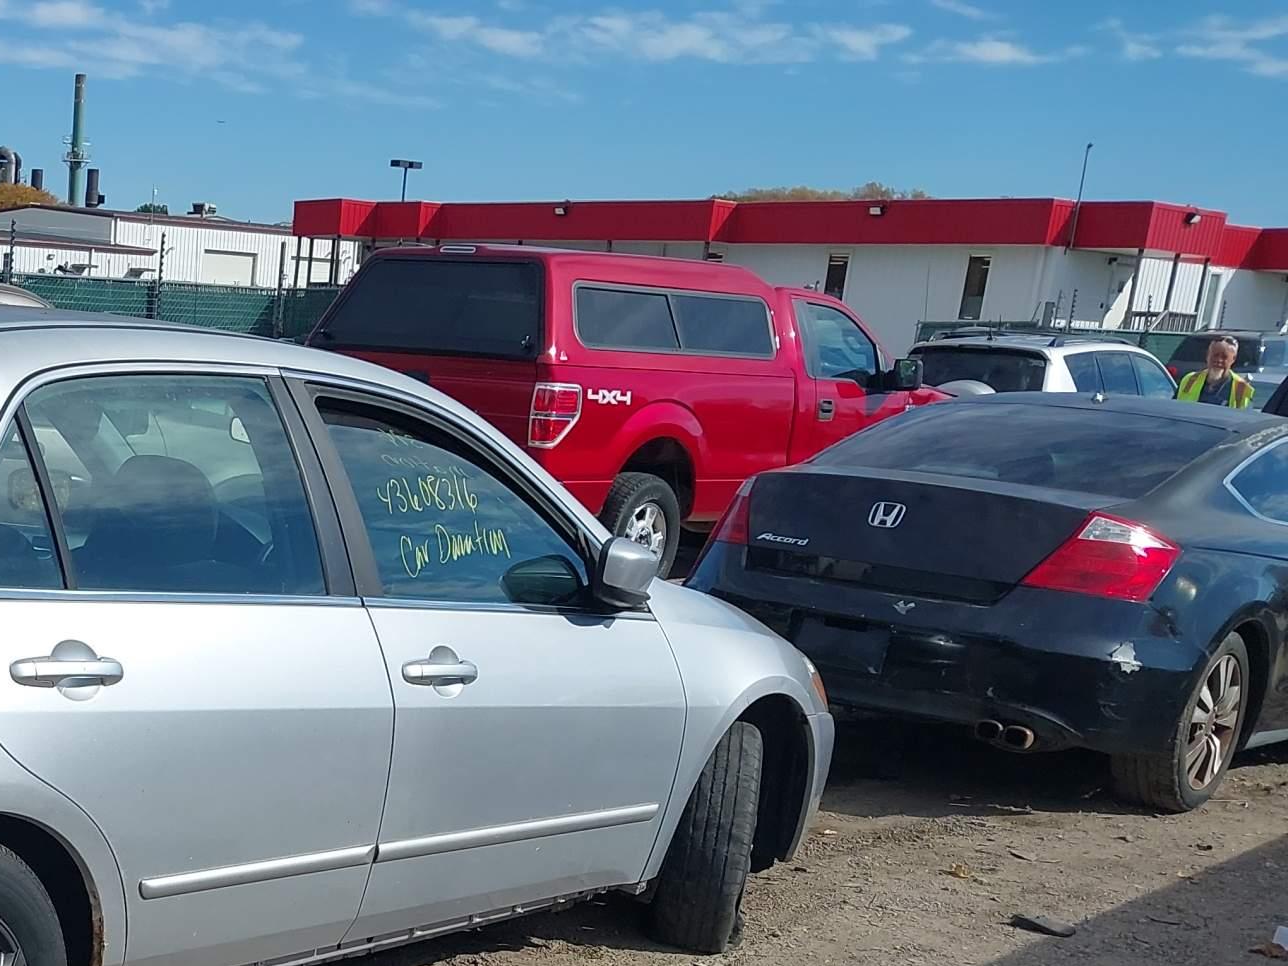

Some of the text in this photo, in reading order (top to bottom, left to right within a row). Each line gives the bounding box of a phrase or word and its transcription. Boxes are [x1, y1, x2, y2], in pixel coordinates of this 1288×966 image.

[377, 474, 478, 514] 43608316
[400, 535, 430, 578] Car
[756, 532, 809, 546] Accord
